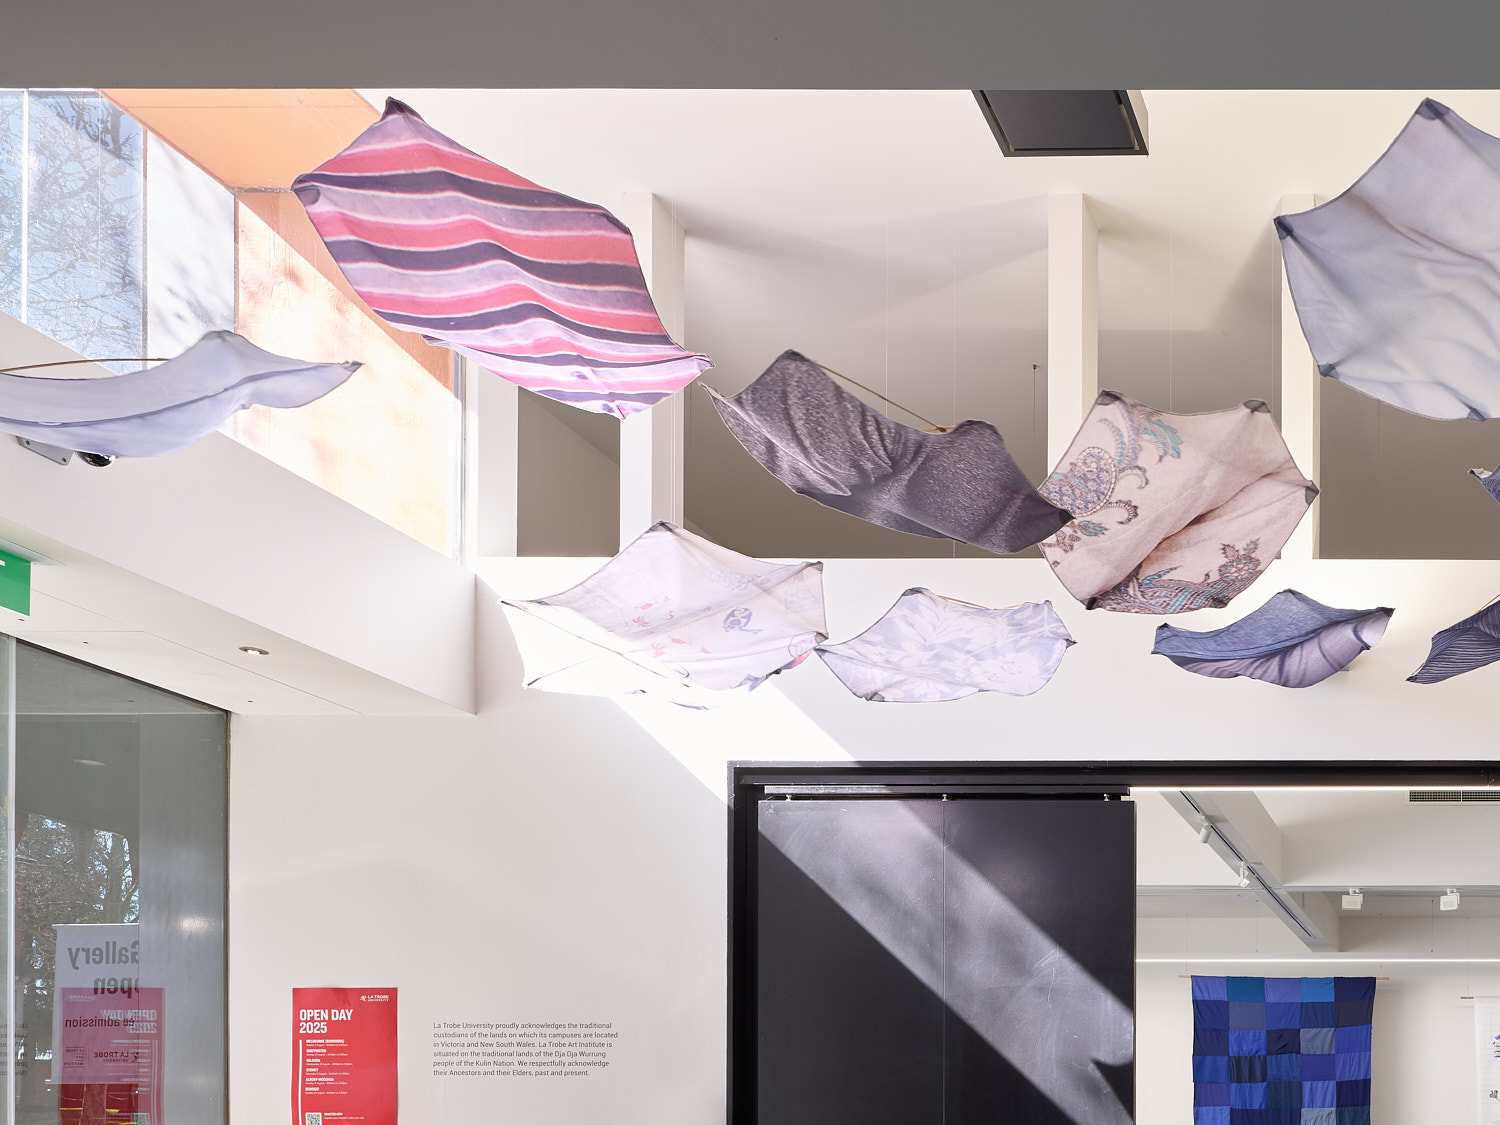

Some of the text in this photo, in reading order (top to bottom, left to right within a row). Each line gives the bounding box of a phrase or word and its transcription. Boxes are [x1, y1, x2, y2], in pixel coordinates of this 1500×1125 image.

[299, 1009, 353, 1021] OPEN DAY
[299, 1022, 328, 1034] 2025
[462, 1022, 494, 1031] University
[495, 1022, 520, 1031] proudly
[520, 1022, 566, 1031] acknowledges
[554, 1051, 565, 1059] Dja
[566, 1051, 578, 1059] Dja
[578, 1051, 606, 1059] Wurrung
[433, 1060, 454, 1069] people
[529, 1060, 566, 1069] respectfully
[567, 1060, 609, 1069] acknowledge
[512, 1070, 534, 1078] Elders,
[534, 1070, 549, 1078] past
[564, 1070, 590, 1078] present.
